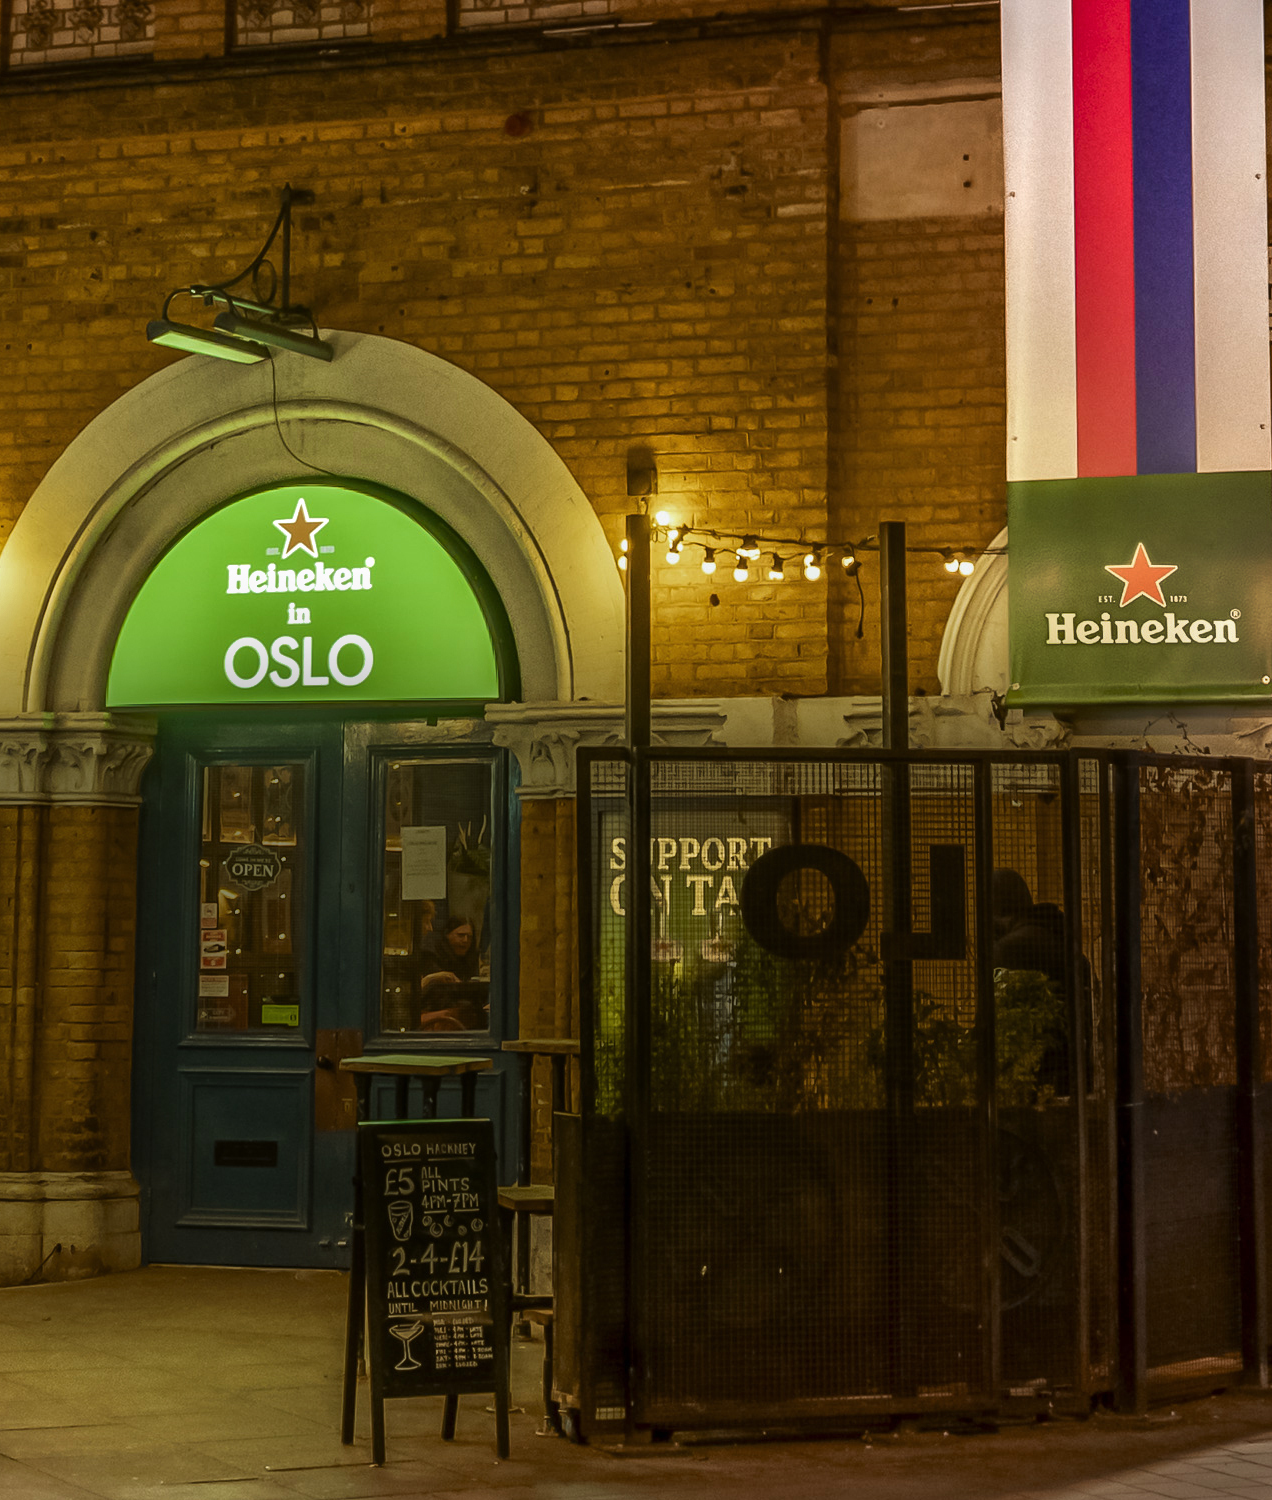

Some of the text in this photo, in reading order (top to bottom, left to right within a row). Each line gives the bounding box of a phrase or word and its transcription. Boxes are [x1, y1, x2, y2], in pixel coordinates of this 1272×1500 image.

[226, 562, 373, 594] Heineken
[287, 603, 311, 624] in
[224, 634, 374, 689] OSLO
[610, 837, 772, 871] SPPORT
[232, 862, 274, 878] OPEN
[686, 875, 740, 916] TA
[381, 1142, 476, 1157] OSLO HACKNEY
[384, 1167, 415, 1196] £5
[421, 1166, 441, 1179] ALL
[422, 1177, 470, 1192] PINTS
[387, 1278, 488, 1299] ALL COCKTAILS
[388, 1302, 418, 1314] UNTIL
